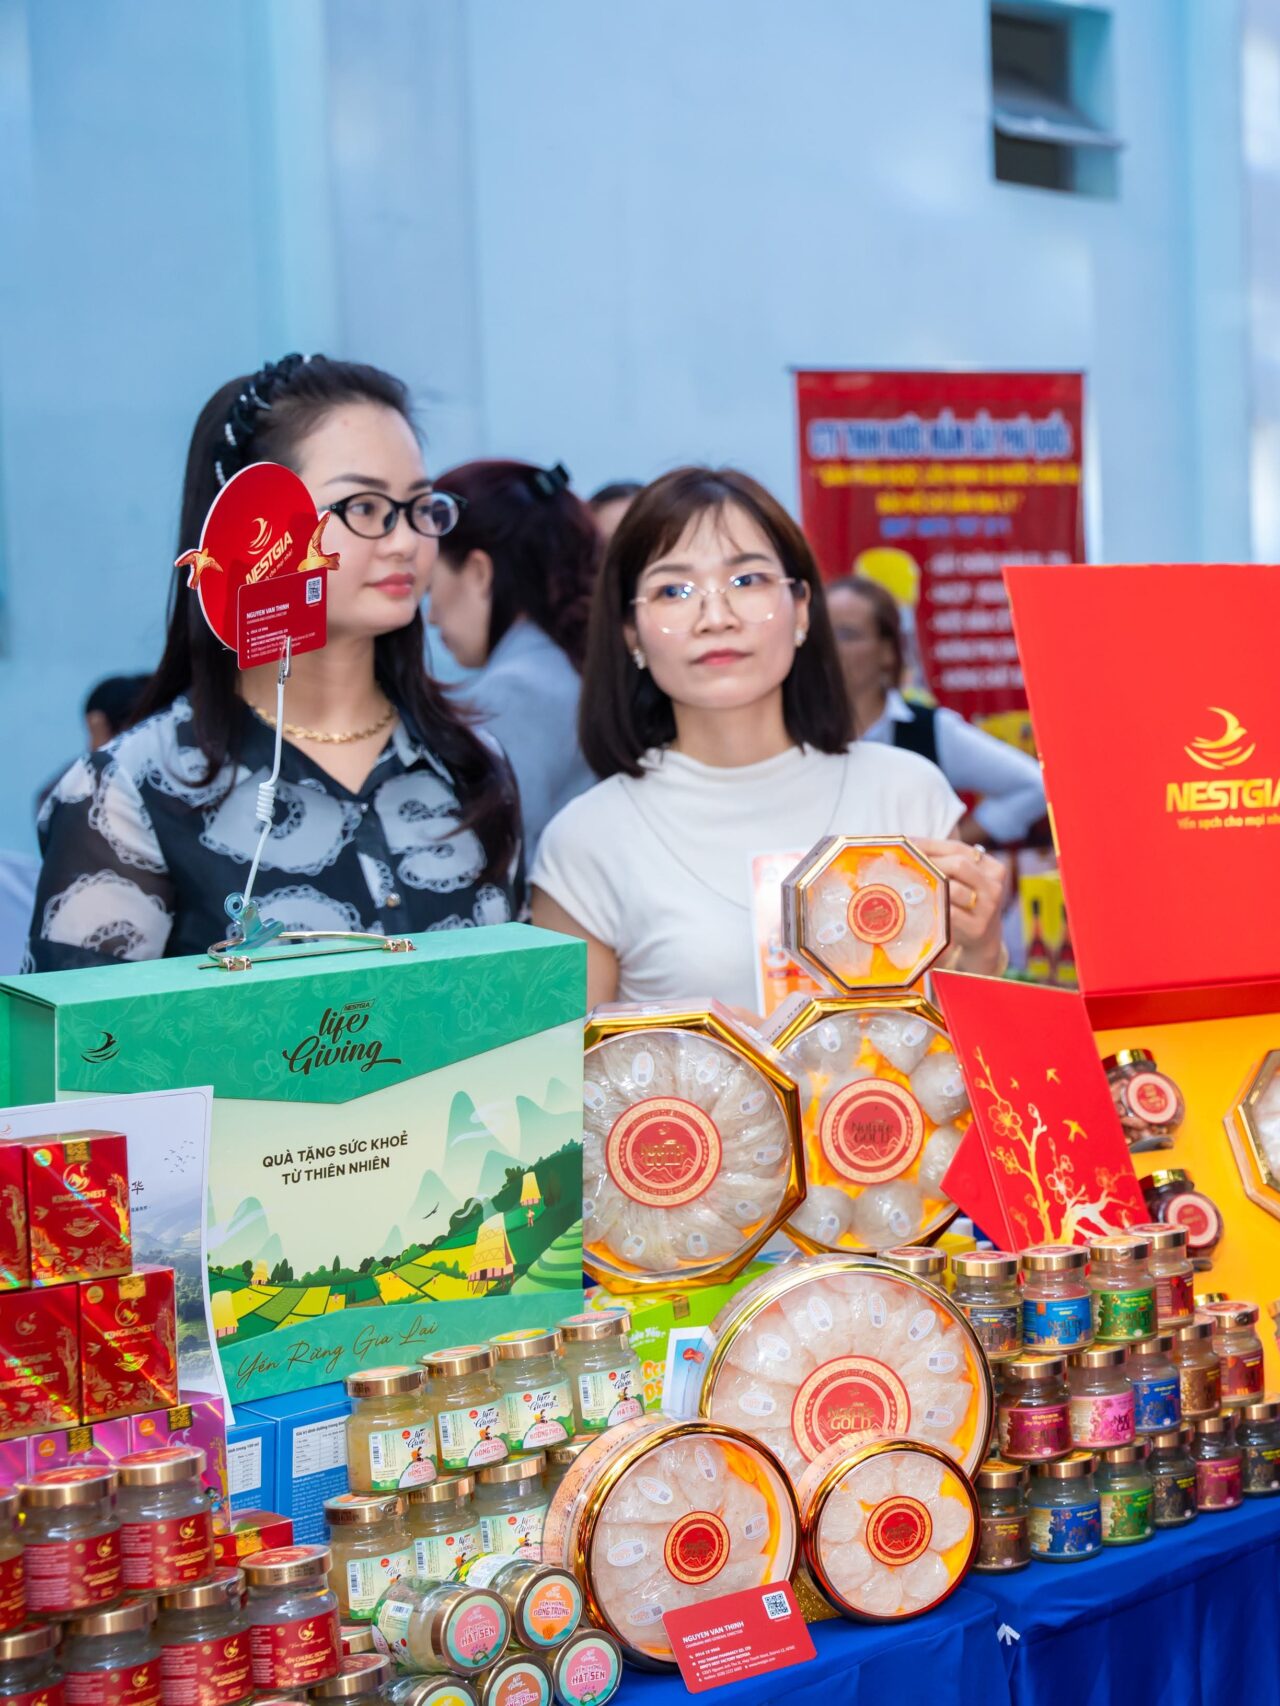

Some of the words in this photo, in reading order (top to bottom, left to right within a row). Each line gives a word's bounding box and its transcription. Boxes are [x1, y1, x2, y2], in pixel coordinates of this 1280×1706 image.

[246, 531, 293, 584] NESTGIA
[1224, 815, 1244, 827] cho
[319, 1008, 369, 1044] life
[282, 1035, 402, 1075] Giving
[262, 1149, 294, 1168] QUÀ
[297, 1145, 336, 1164] TẶNG
[338, 1138, 367, 1156] SỨC
[370, 1130, 409, 1151] KHOẺ
[281, 1168, 302, 1185] TỪ
[304, 1163, 346, 1181] THIÊN
[349, 1156, 390, 1175] NHIÊN
[236, 1351, 280, 1389] Yến
[287, 1340, 345, 1374] Rừng
[352, 1325, 393, 1361] Gia
[399, 1315, 439, 1346] Lai
[830, 1416, 872, 1430] GOLD
[479, 1626, 496, 1639] SEN
[683, 1630, 710, 1643] NGUYEN
[710, 1626, 724, 1635] VAN
[724, 1621, 744, 1631] THINH
[590, 1671, 606, 1681] SEN
